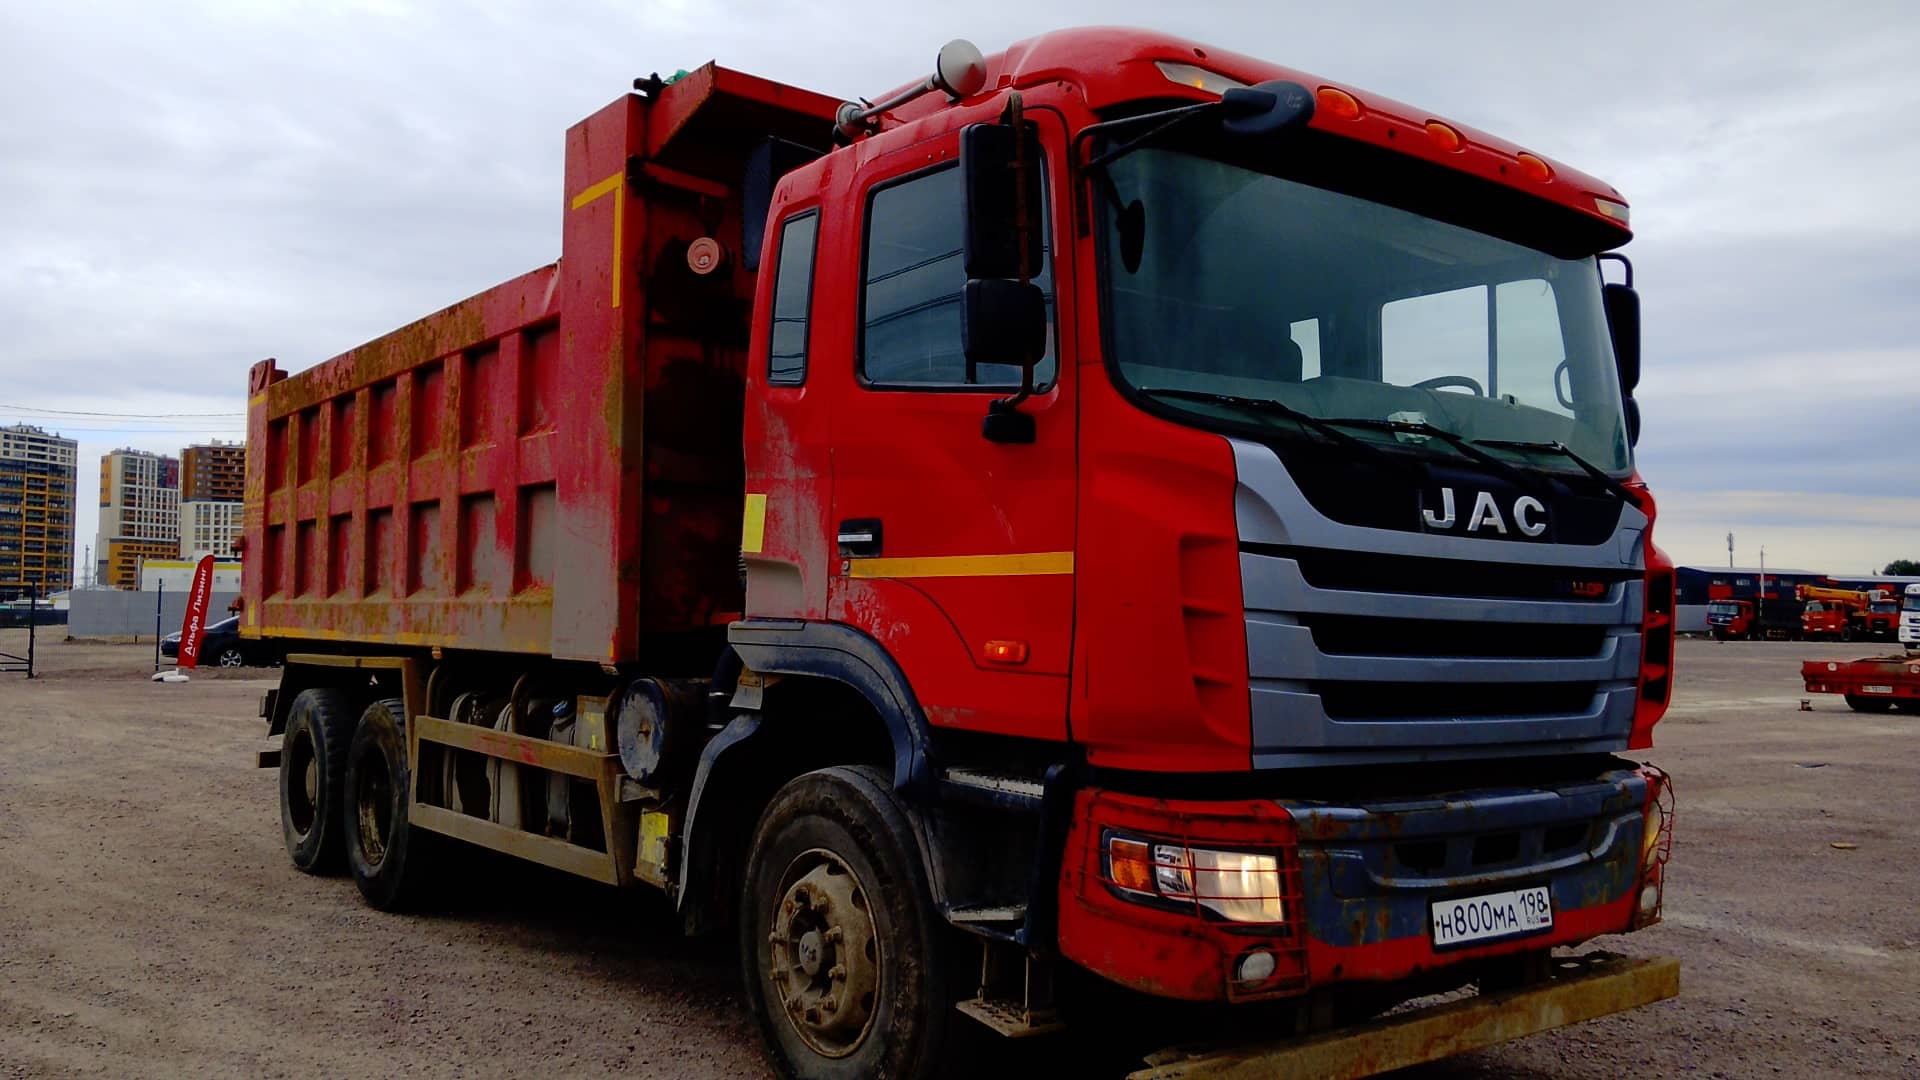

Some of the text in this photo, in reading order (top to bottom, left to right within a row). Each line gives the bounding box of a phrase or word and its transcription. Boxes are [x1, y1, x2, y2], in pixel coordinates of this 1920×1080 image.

[1422, 487, 1547, 537] JAC
[184, 567, 207, 656] Альфа Лизинг
[1519, 891, 1545, 917] 198
